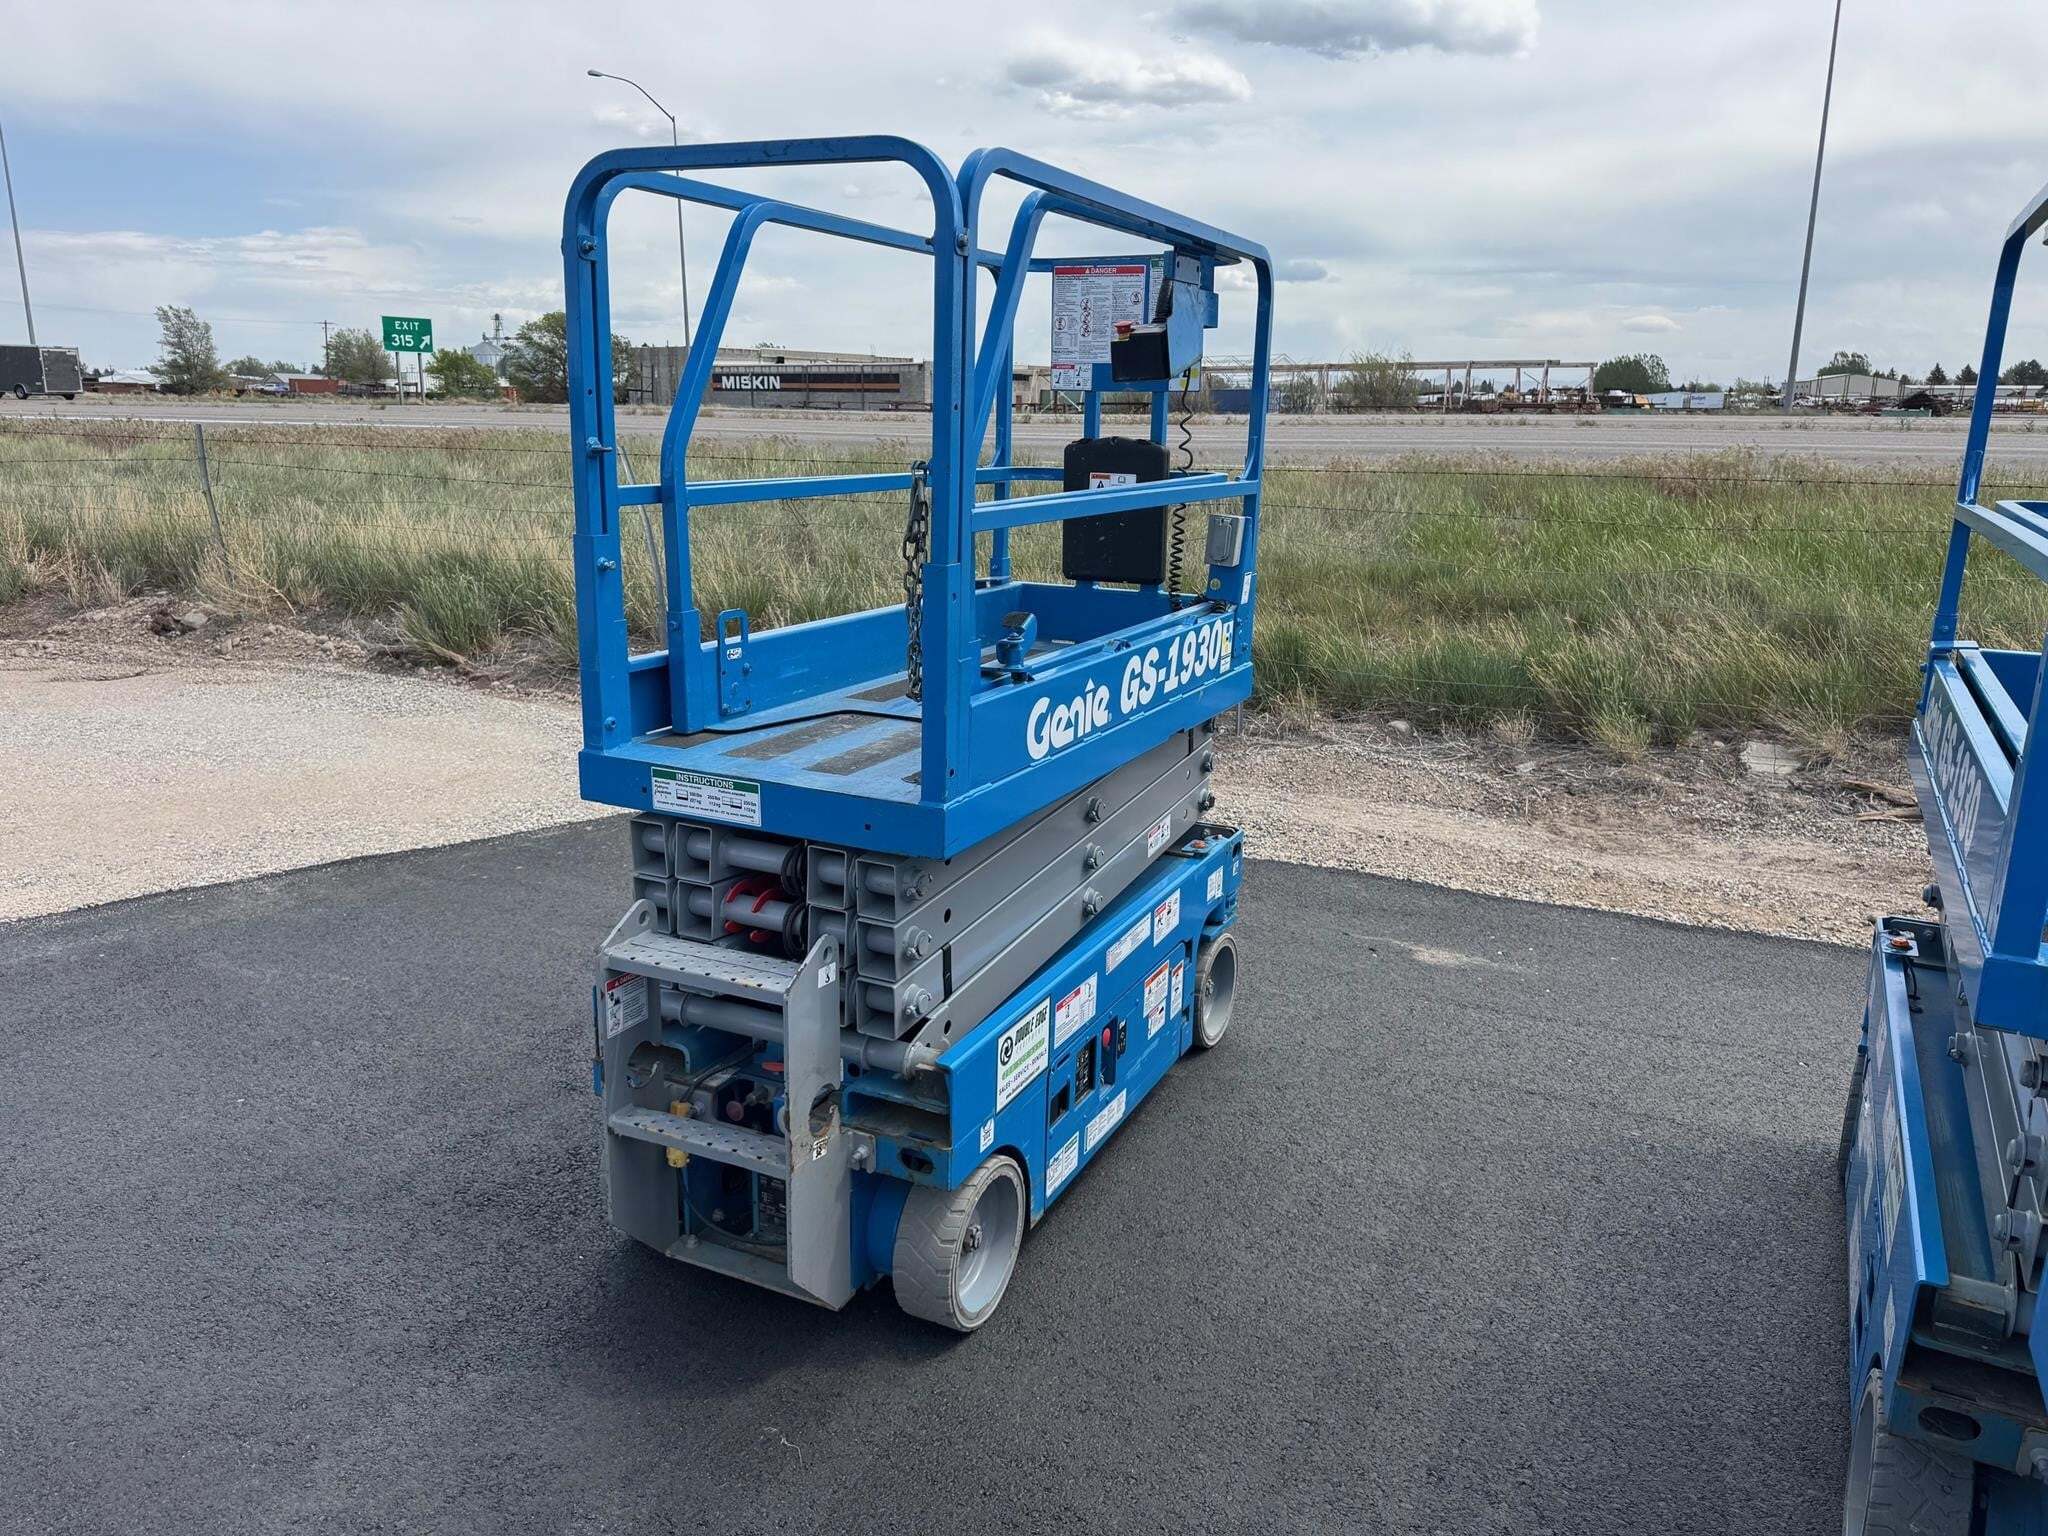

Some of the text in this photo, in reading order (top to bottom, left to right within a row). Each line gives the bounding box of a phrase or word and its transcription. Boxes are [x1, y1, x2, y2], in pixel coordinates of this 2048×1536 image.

[394, 320, 420, 331] EXIT
[391, 333, 414, 347] 315
[721, 375, 781, 389] MISKIN
[1026, 619, 1223, 760] Genie GS-1930
[675, 772, 734, 789] INSTRUCTIONS
[1938, 711, 1982, 858] GS-1930
